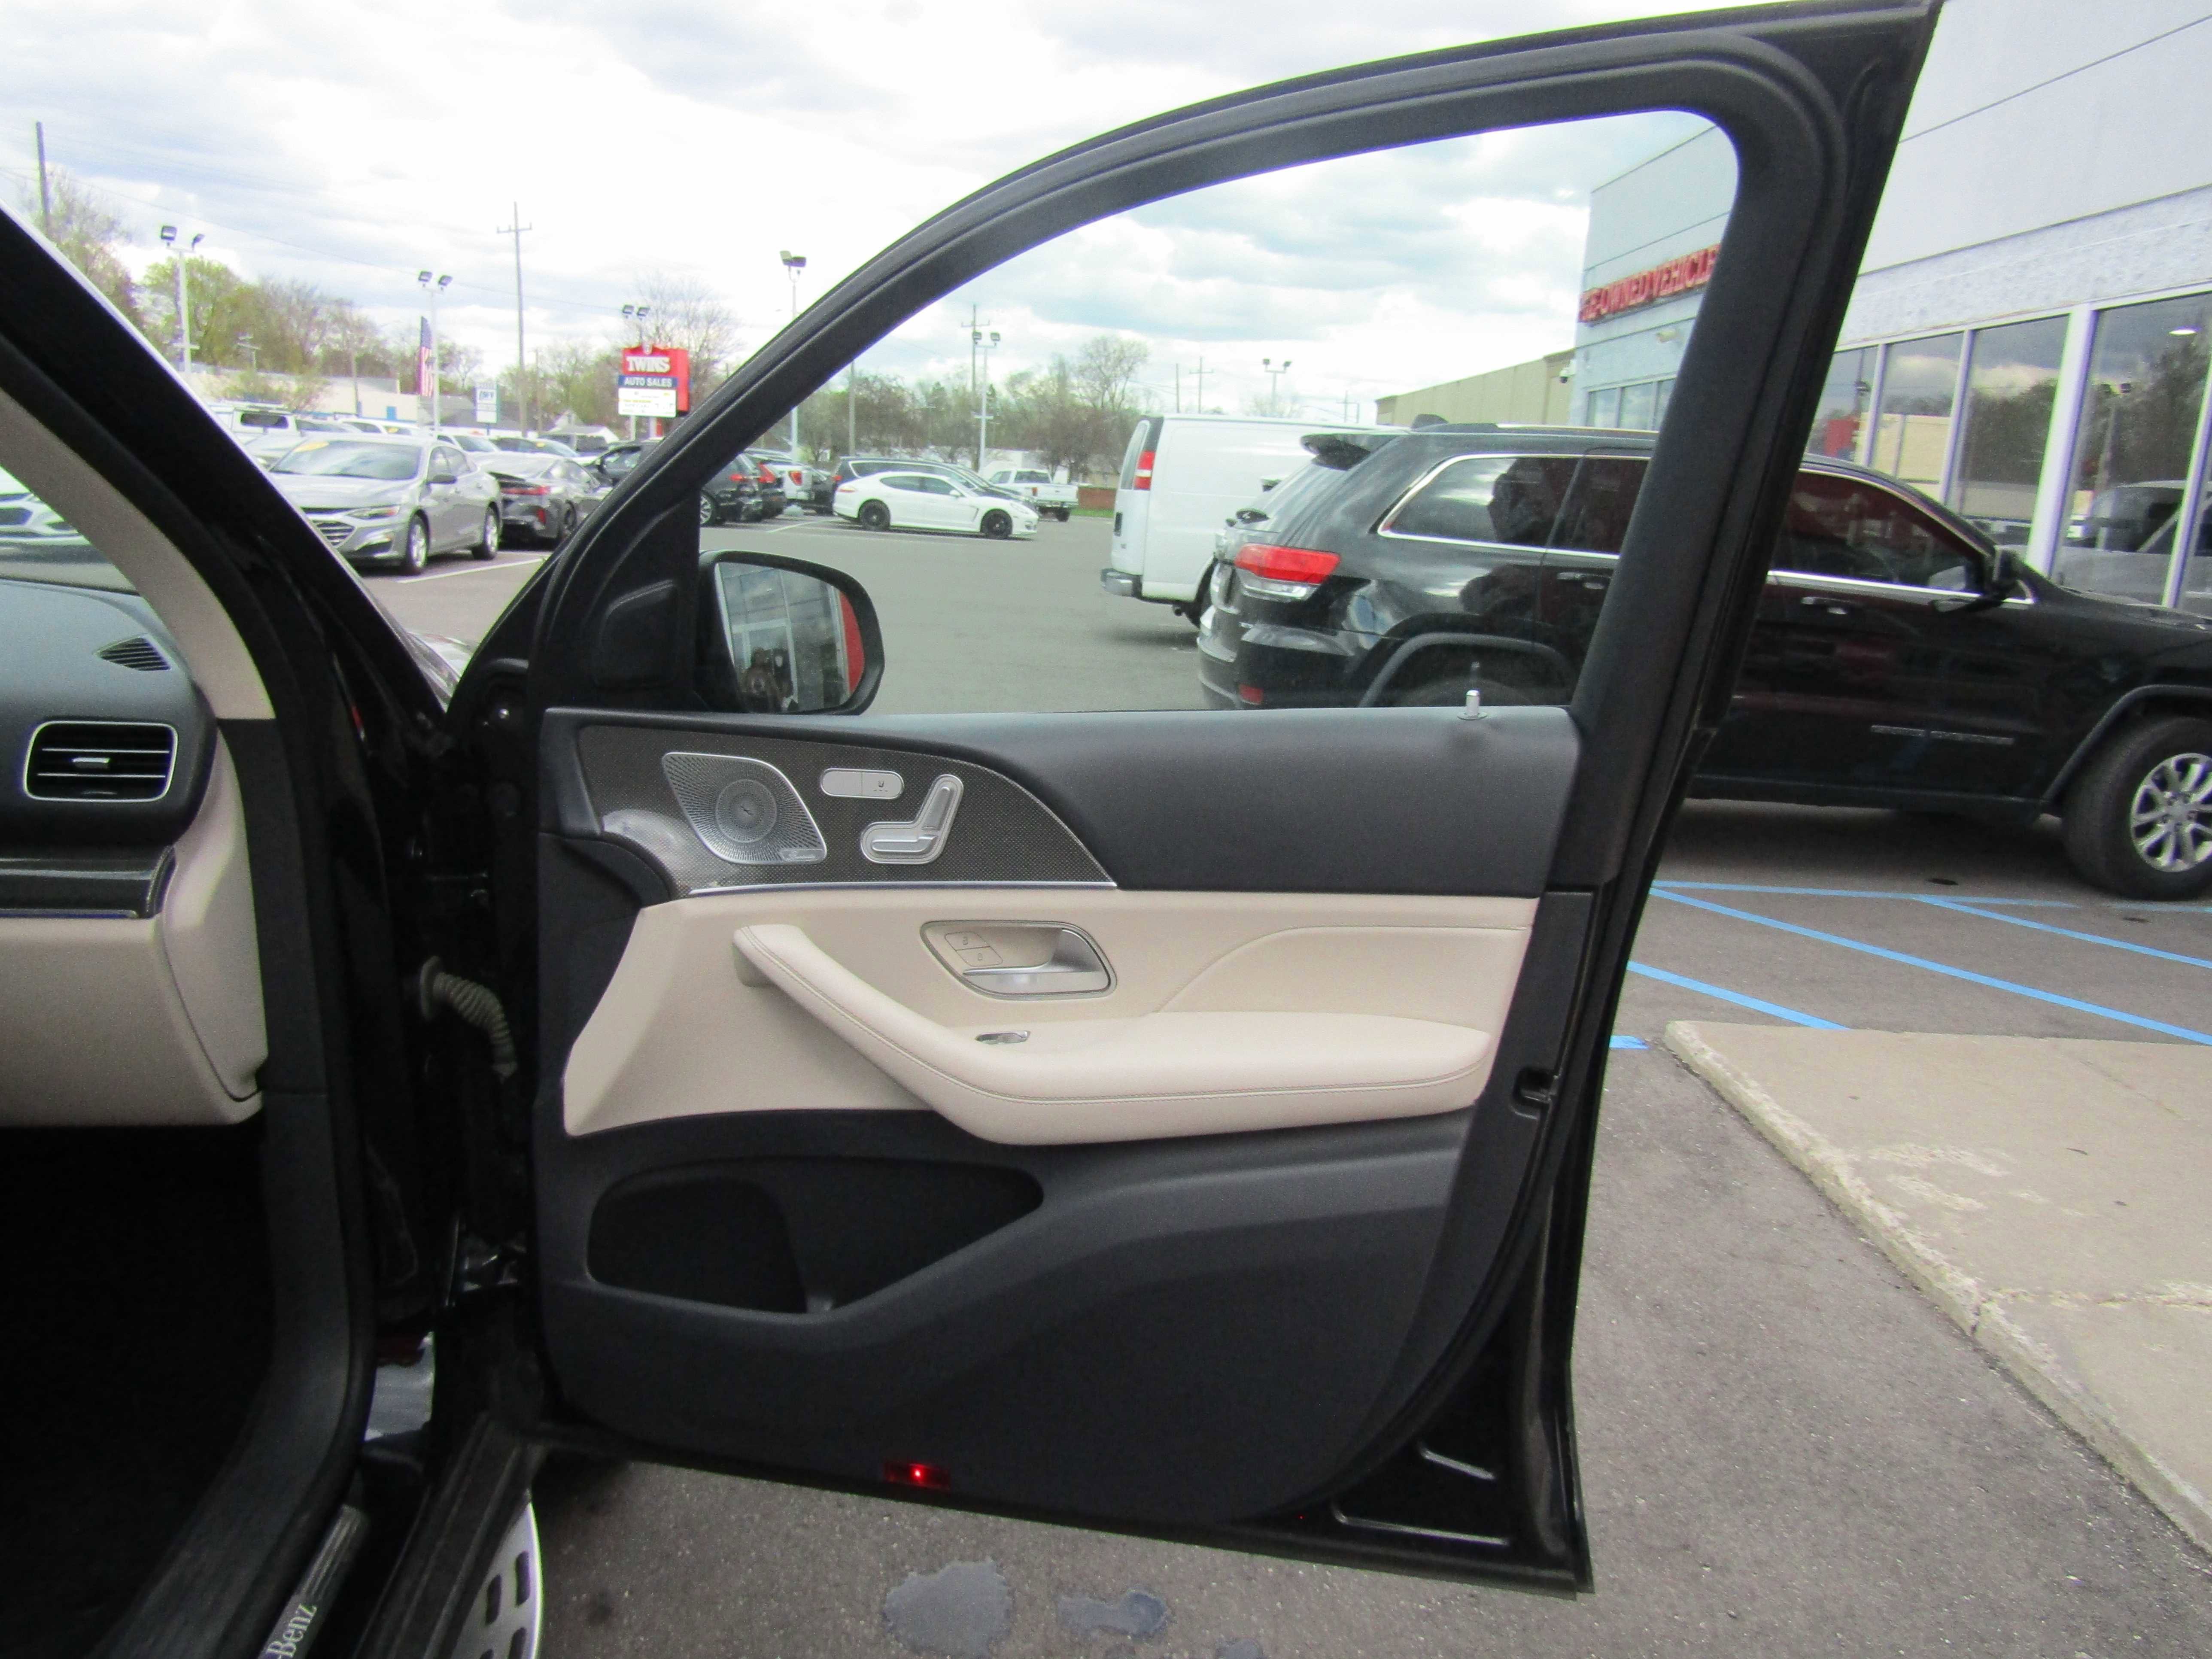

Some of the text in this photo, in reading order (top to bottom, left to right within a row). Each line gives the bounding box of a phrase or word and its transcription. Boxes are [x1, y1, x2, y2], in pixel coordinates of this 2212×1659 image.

[626, 356, 670, 373] TWINS
[625, 377, 672, 387] AUTO SALES
